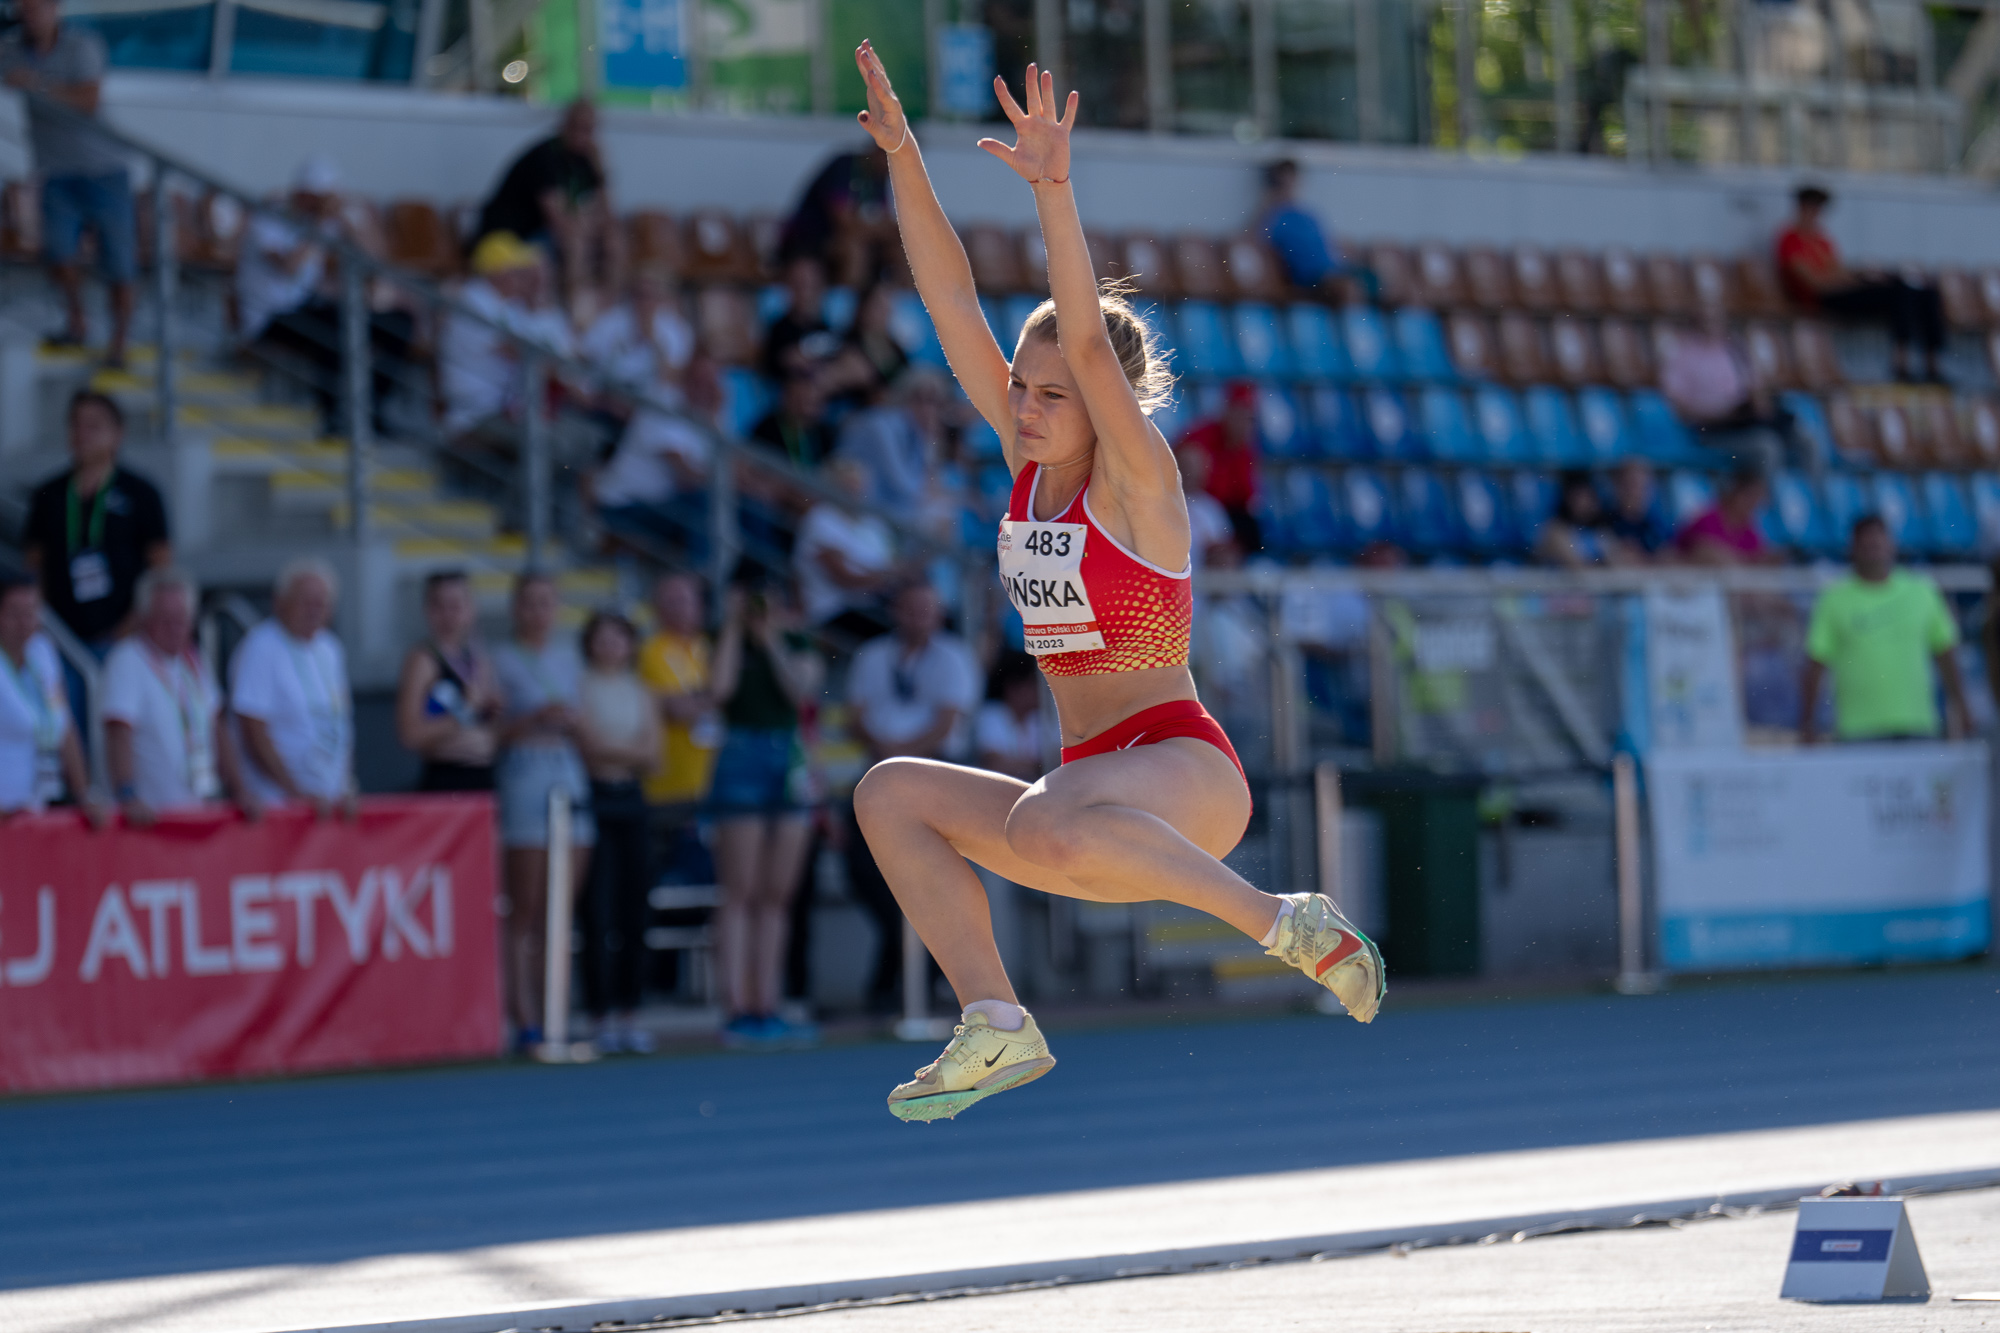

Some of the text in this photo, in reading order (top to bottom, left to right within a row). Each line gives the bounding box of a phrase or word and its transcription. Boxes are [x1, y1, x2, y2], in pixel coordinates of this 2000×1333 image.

[1025, 530, 1071, 556] 483
[1047, 625, 1070, 634] Polski
[1071, 624, 1088, 633] U20
[1036, 638, 1064, 649] 2023
[80, 866, 454, 980] ATLETYKI
[1301, 922, 1316, 959] NIKE
